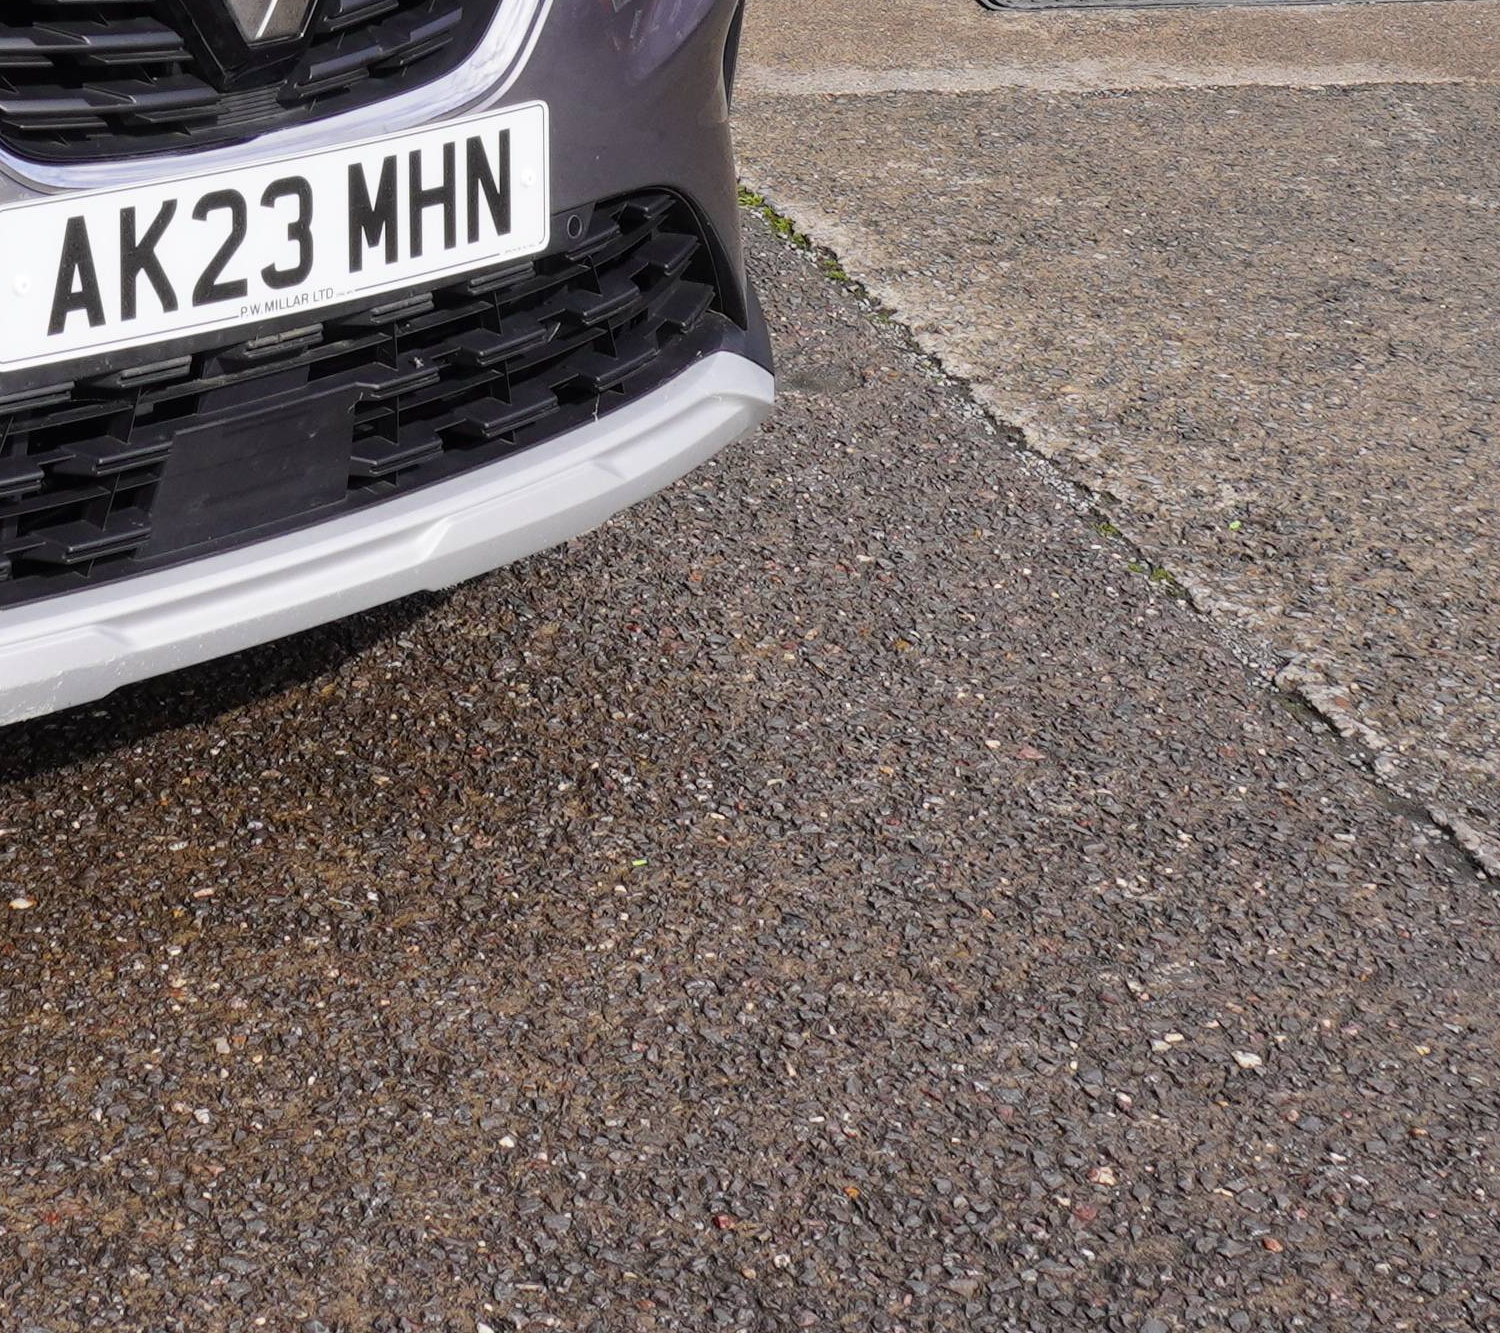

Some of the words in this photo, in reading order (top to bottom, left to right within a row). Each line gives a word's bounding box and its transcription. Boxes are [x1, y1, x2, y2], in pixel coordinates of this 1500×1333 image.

[47, 175, 314, 336] AK23
[348, 129, 511, 273] MHN
[313, 287, 334, 302] LTD
